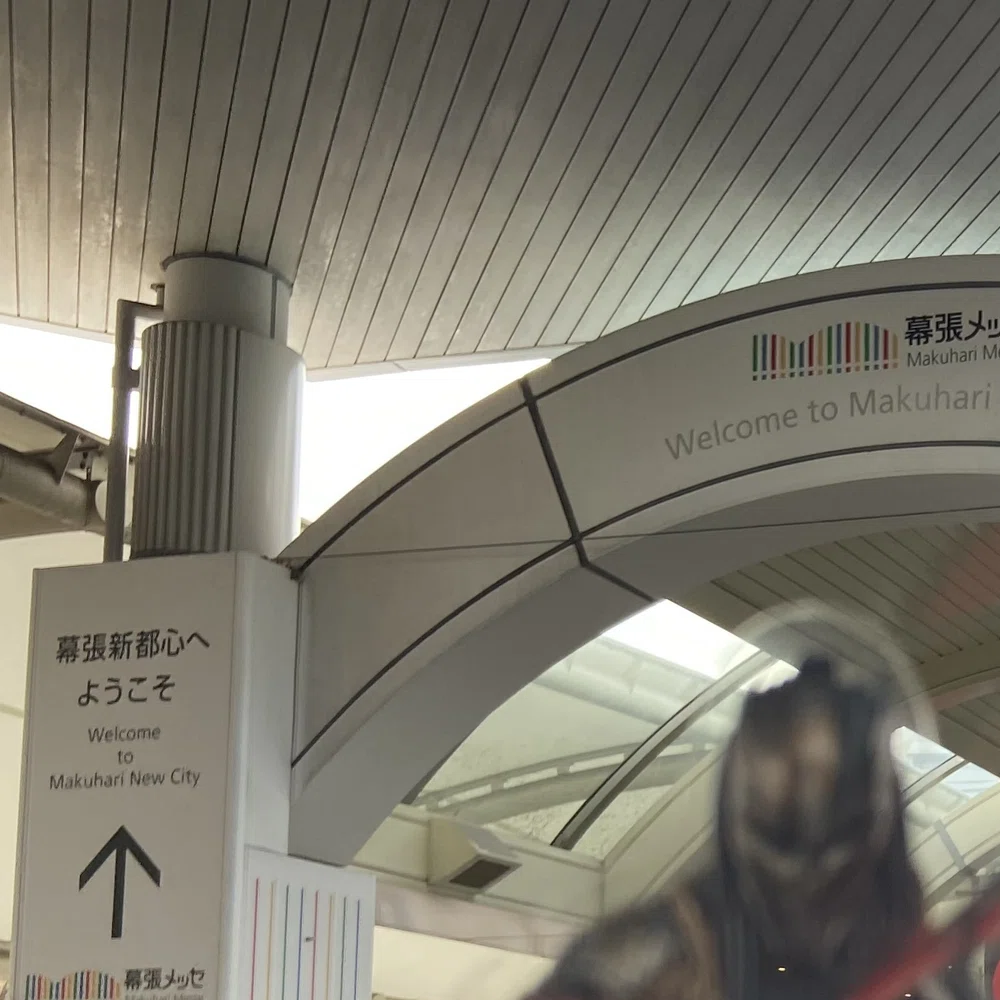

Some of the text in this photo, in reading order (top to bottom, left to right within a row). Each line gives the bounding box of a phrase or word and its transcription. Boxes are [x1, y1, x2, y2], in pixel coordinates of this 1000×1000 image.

[907, 345, 977, 367] Makuhari
[664, 407, 798, 460] Welcome
[807, 400, 838, 423] to
[850, 383, 991, 417] Makuhari
[56, 628, 210, 664] 幕張新都心へ
[78, 674, 175, 706] ようこそ
[88, 726, 161, 743] Welcome
[118, 750, 134, 765] to
[50, 766, 200, 790] Makuhari New City
[124, 967, 205, 991] 幕張メッセ
